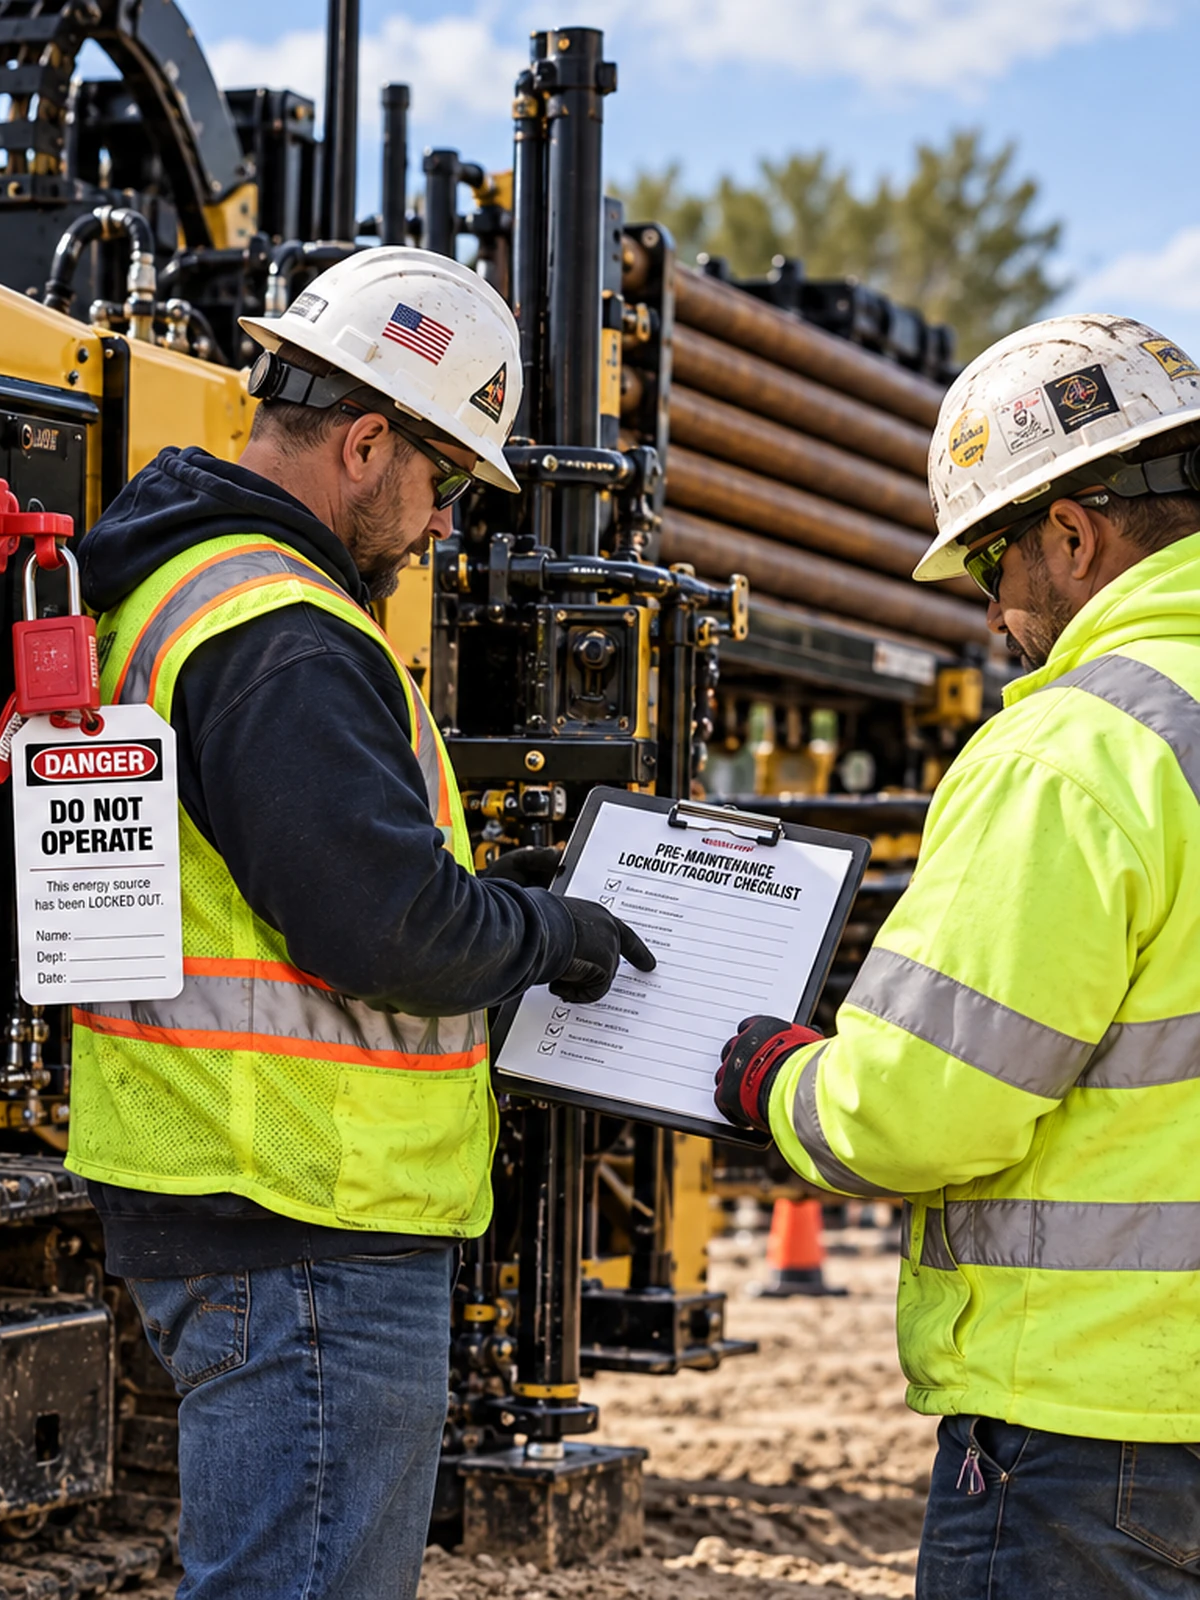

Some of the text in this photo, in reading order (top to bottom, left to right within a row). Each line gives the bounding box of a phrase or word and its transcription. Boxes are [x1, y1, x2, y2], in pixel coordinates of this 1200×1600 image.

[44, 750, 145, 776] DANGER
[50, 796, 143, 825] DO NOT
[41, 826, 154, 856] OPERATE
[46, 878, 151, 894] This energy source
[34, 893, 164, 911] has been LOCKED OUT.
[36, 930, 72, 942] Name:
[36, 951, 67, 965] Dept:
[37, 972, 67, 985] Date:
